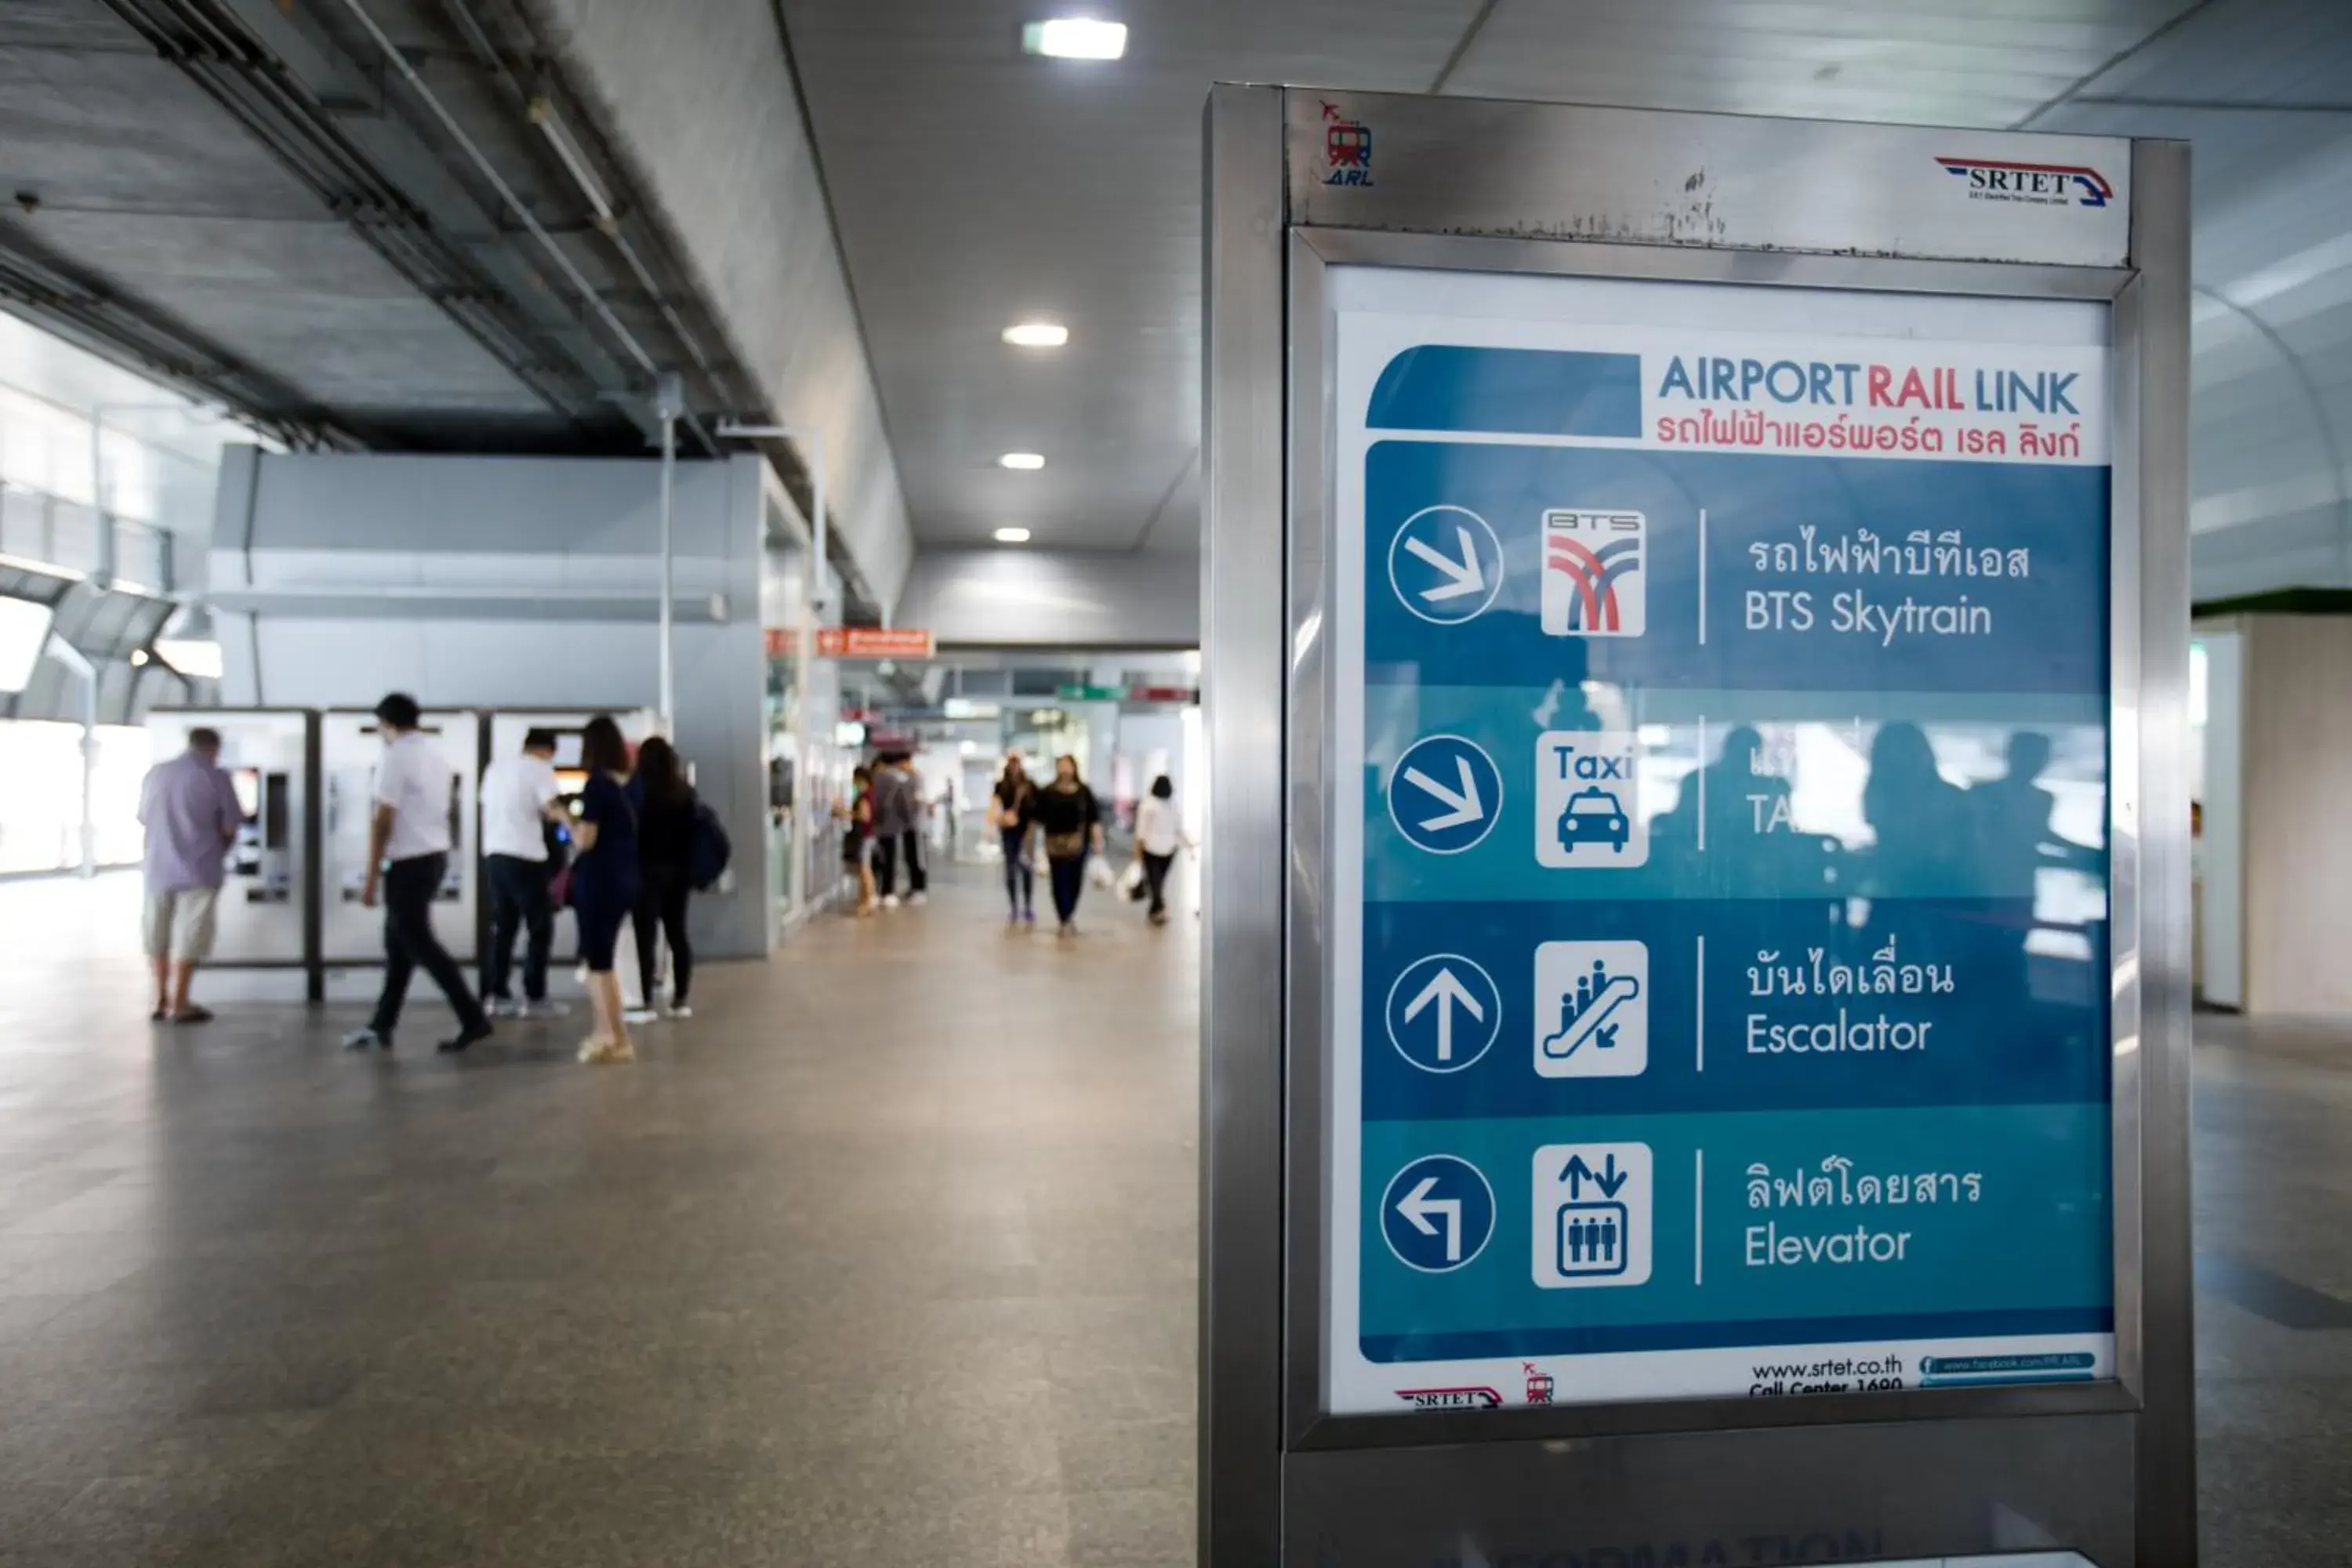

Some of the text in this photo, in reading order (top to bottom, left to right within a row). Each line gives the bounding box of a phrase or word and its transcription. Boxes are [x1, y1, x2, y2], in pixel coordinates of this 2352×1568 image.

[1321, 169, 1374, 187] ARL
[1969, 168, 2071, 194] SRTET
[1976, 368, 2080, 415] LINK
[1548, 513, 1640, 531] BTS
[1748, 524, 2030, 579] รถไฟฟ้าบีทีเอส
[1745, 588, 1991, 647] BTS Skytrain
[1553, 746, 1634, 780] Taxi
[1747, 933, 1955, 996] บันไดเลื่อน
[1747, 1007, 1932, 1053] Escalator
[1746, 1221, 1911, 1265] Elevator
[1752, 1353, 1903, 1379] www.srtet.co.th
[1415, 1392, 1476, 1406] SRTET
